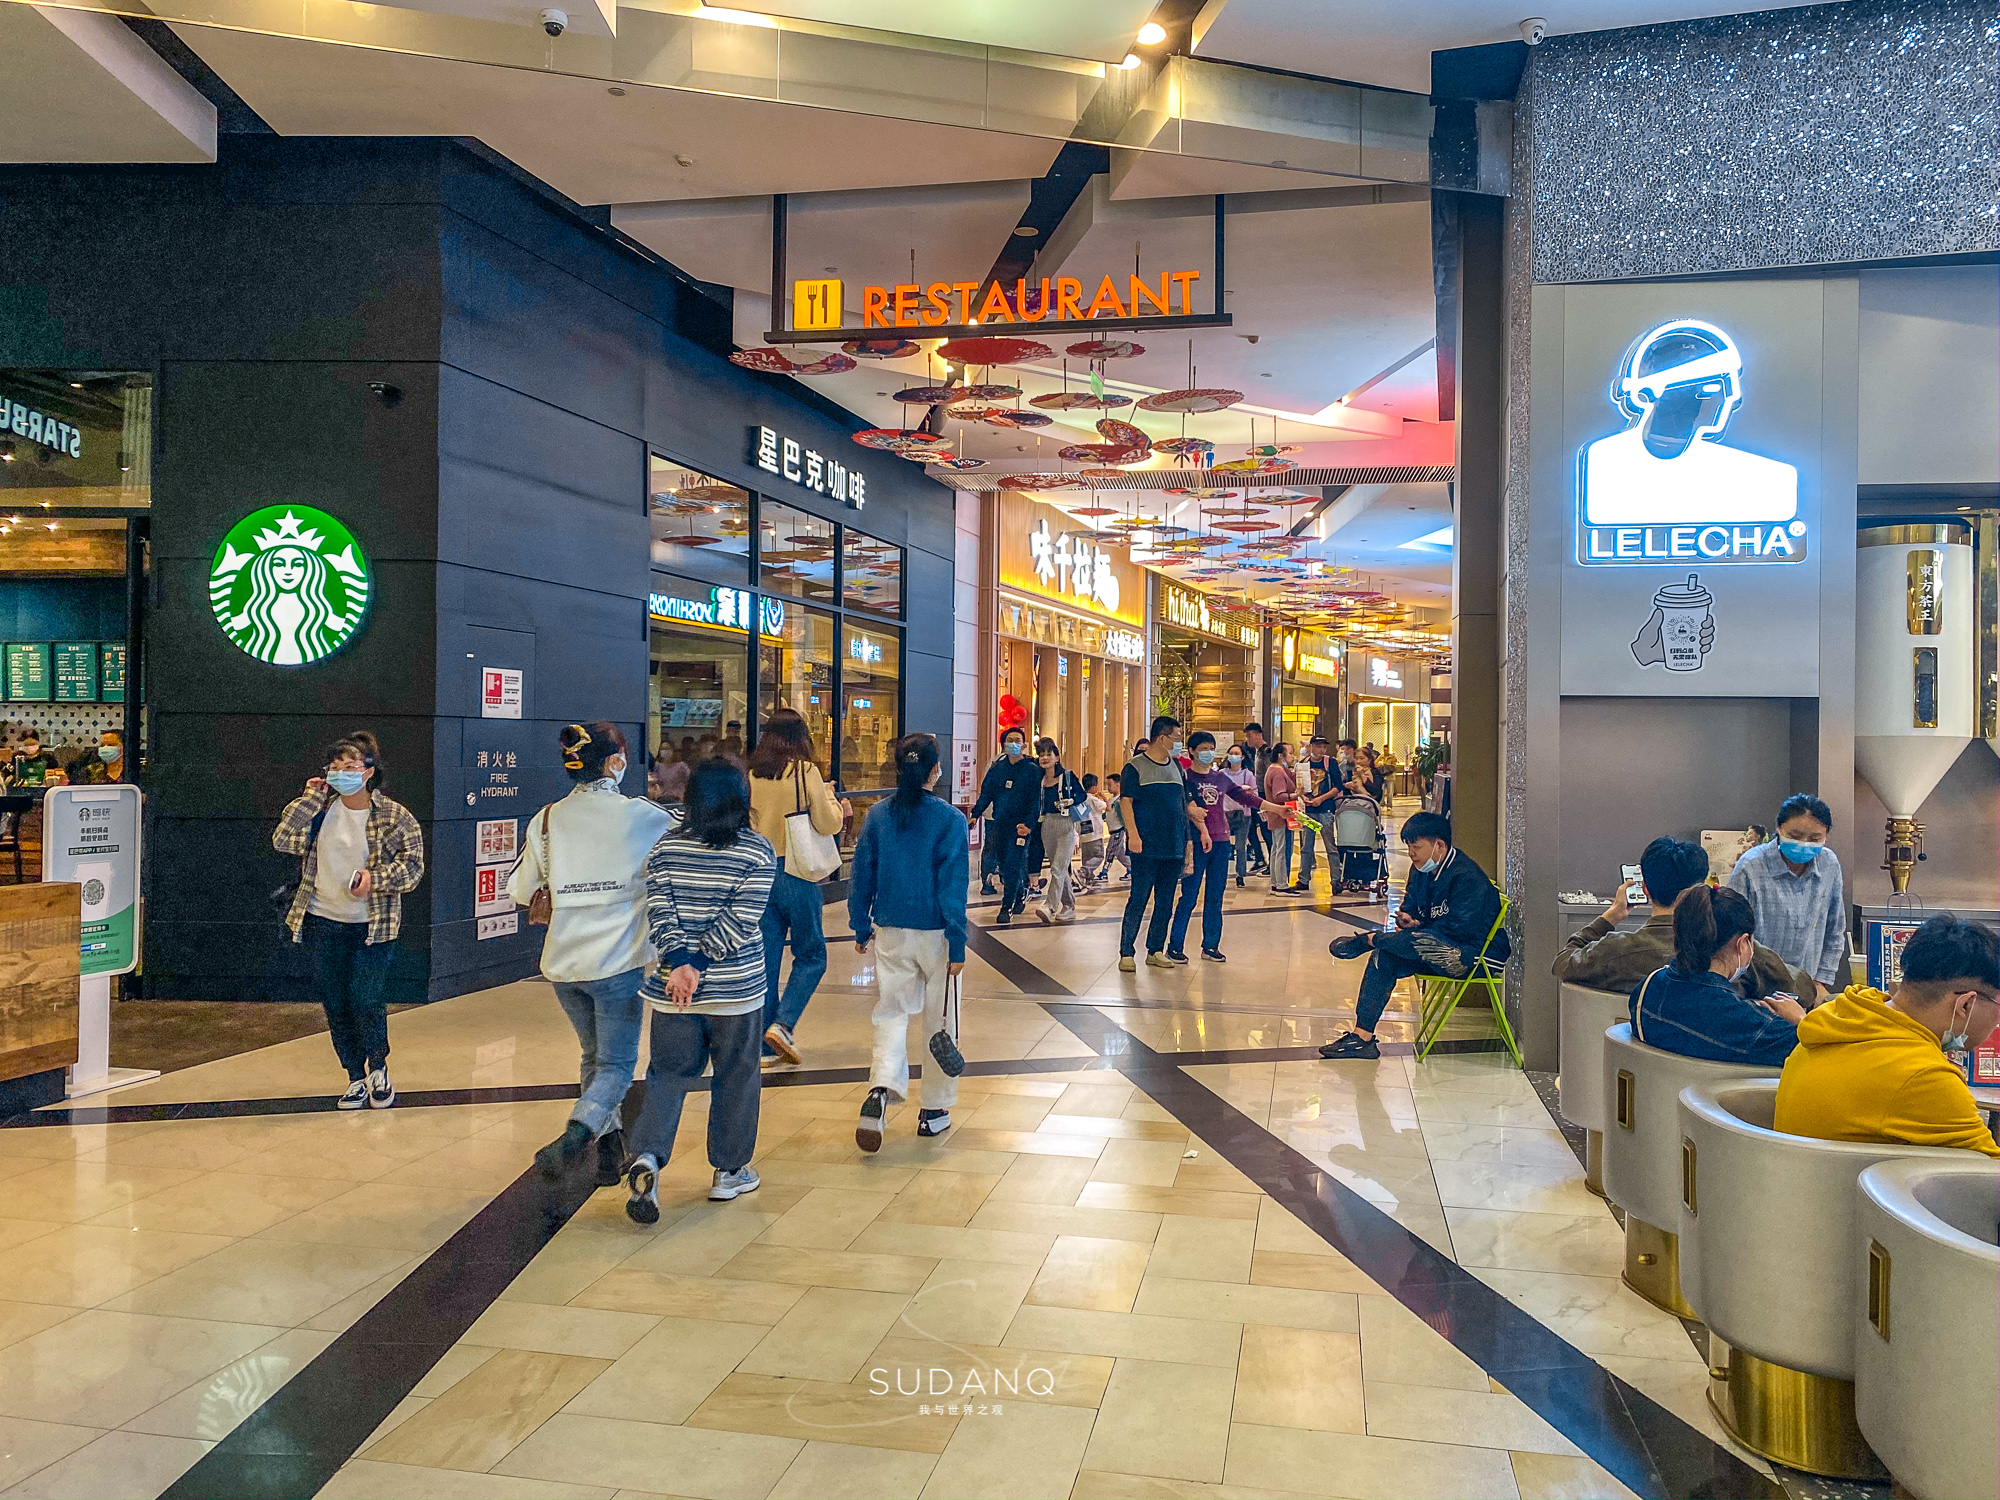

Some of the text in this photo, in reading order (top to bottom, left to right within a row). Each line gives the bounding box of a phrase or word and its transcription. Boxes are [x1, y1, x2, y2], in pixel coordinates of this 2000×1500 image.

[863, 270, 1201, 328] RESTAURANT
[758, 425, 865, 511] 星巴克咖啡
[1590, 526, 1794, 557] LELECHA
[477, 750, 517, 768] 消火栓
[490, 773, 509, 783] FIRE
[480, 786, 519, 797] HYDRANT
